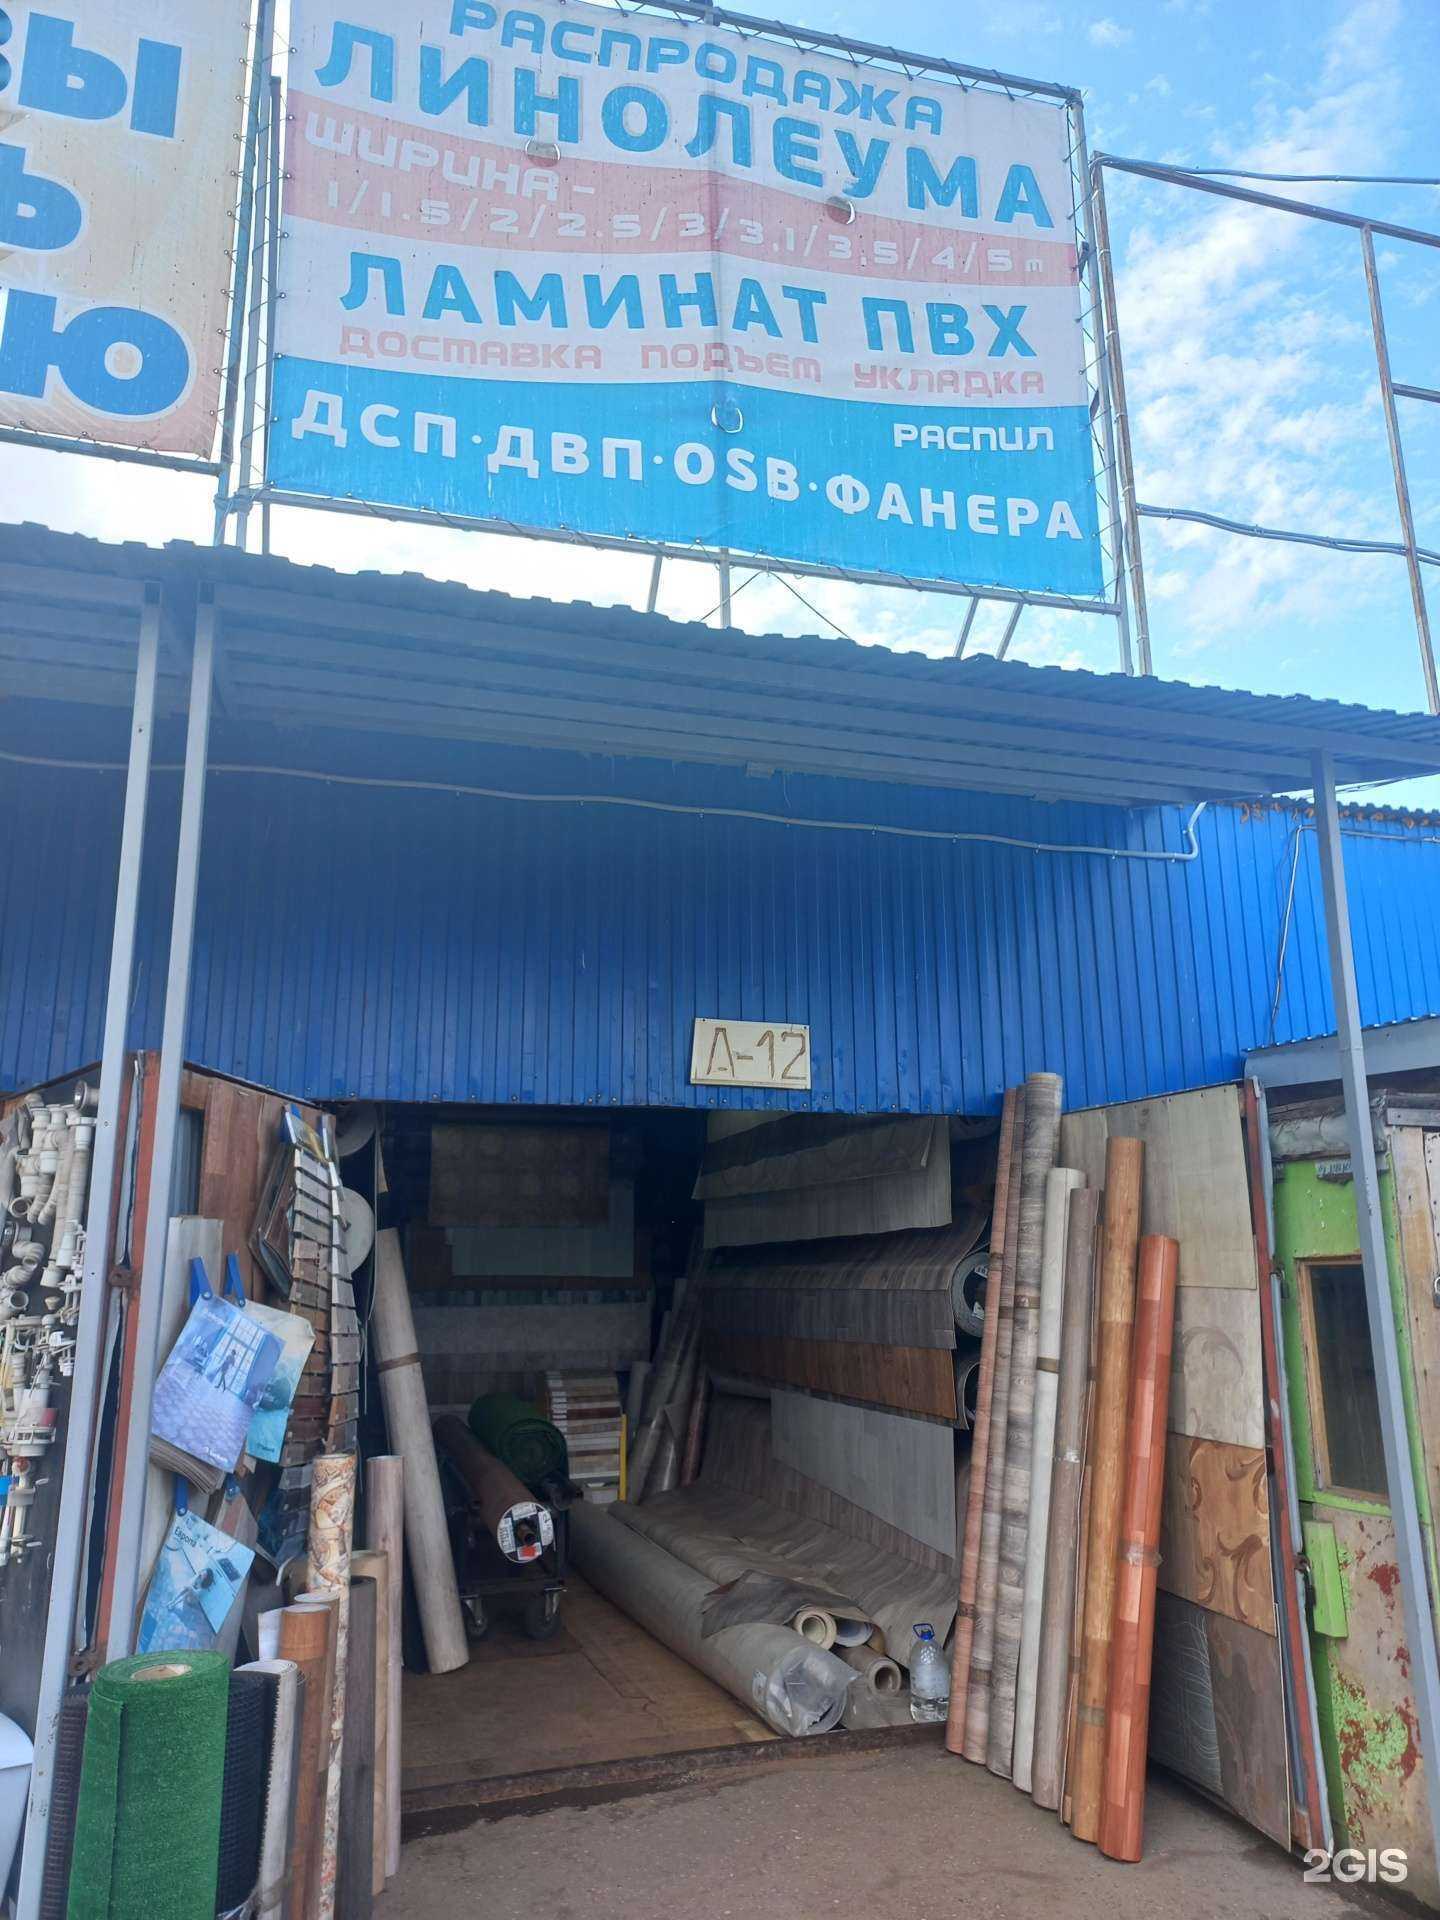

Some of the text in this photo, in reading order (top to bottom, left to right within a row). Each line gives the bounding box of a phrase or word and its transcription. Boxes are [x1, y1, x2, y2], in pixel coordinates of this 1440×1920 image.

[0, 8, 182, 138] Ы
[314, 20, 1055, 228] ЛИНОЛЕУМА
[449, 0, 943, 136] РАСПРОДАЖА
[339, 324, 1044, 398] ДОСТАВКА ПОДЪЕМ УКЛАДКА
[340, 250, 1037, 358] ЛАМИНАТ ПВХ
[894, 422, 1054, 452] РАСПИЛ
